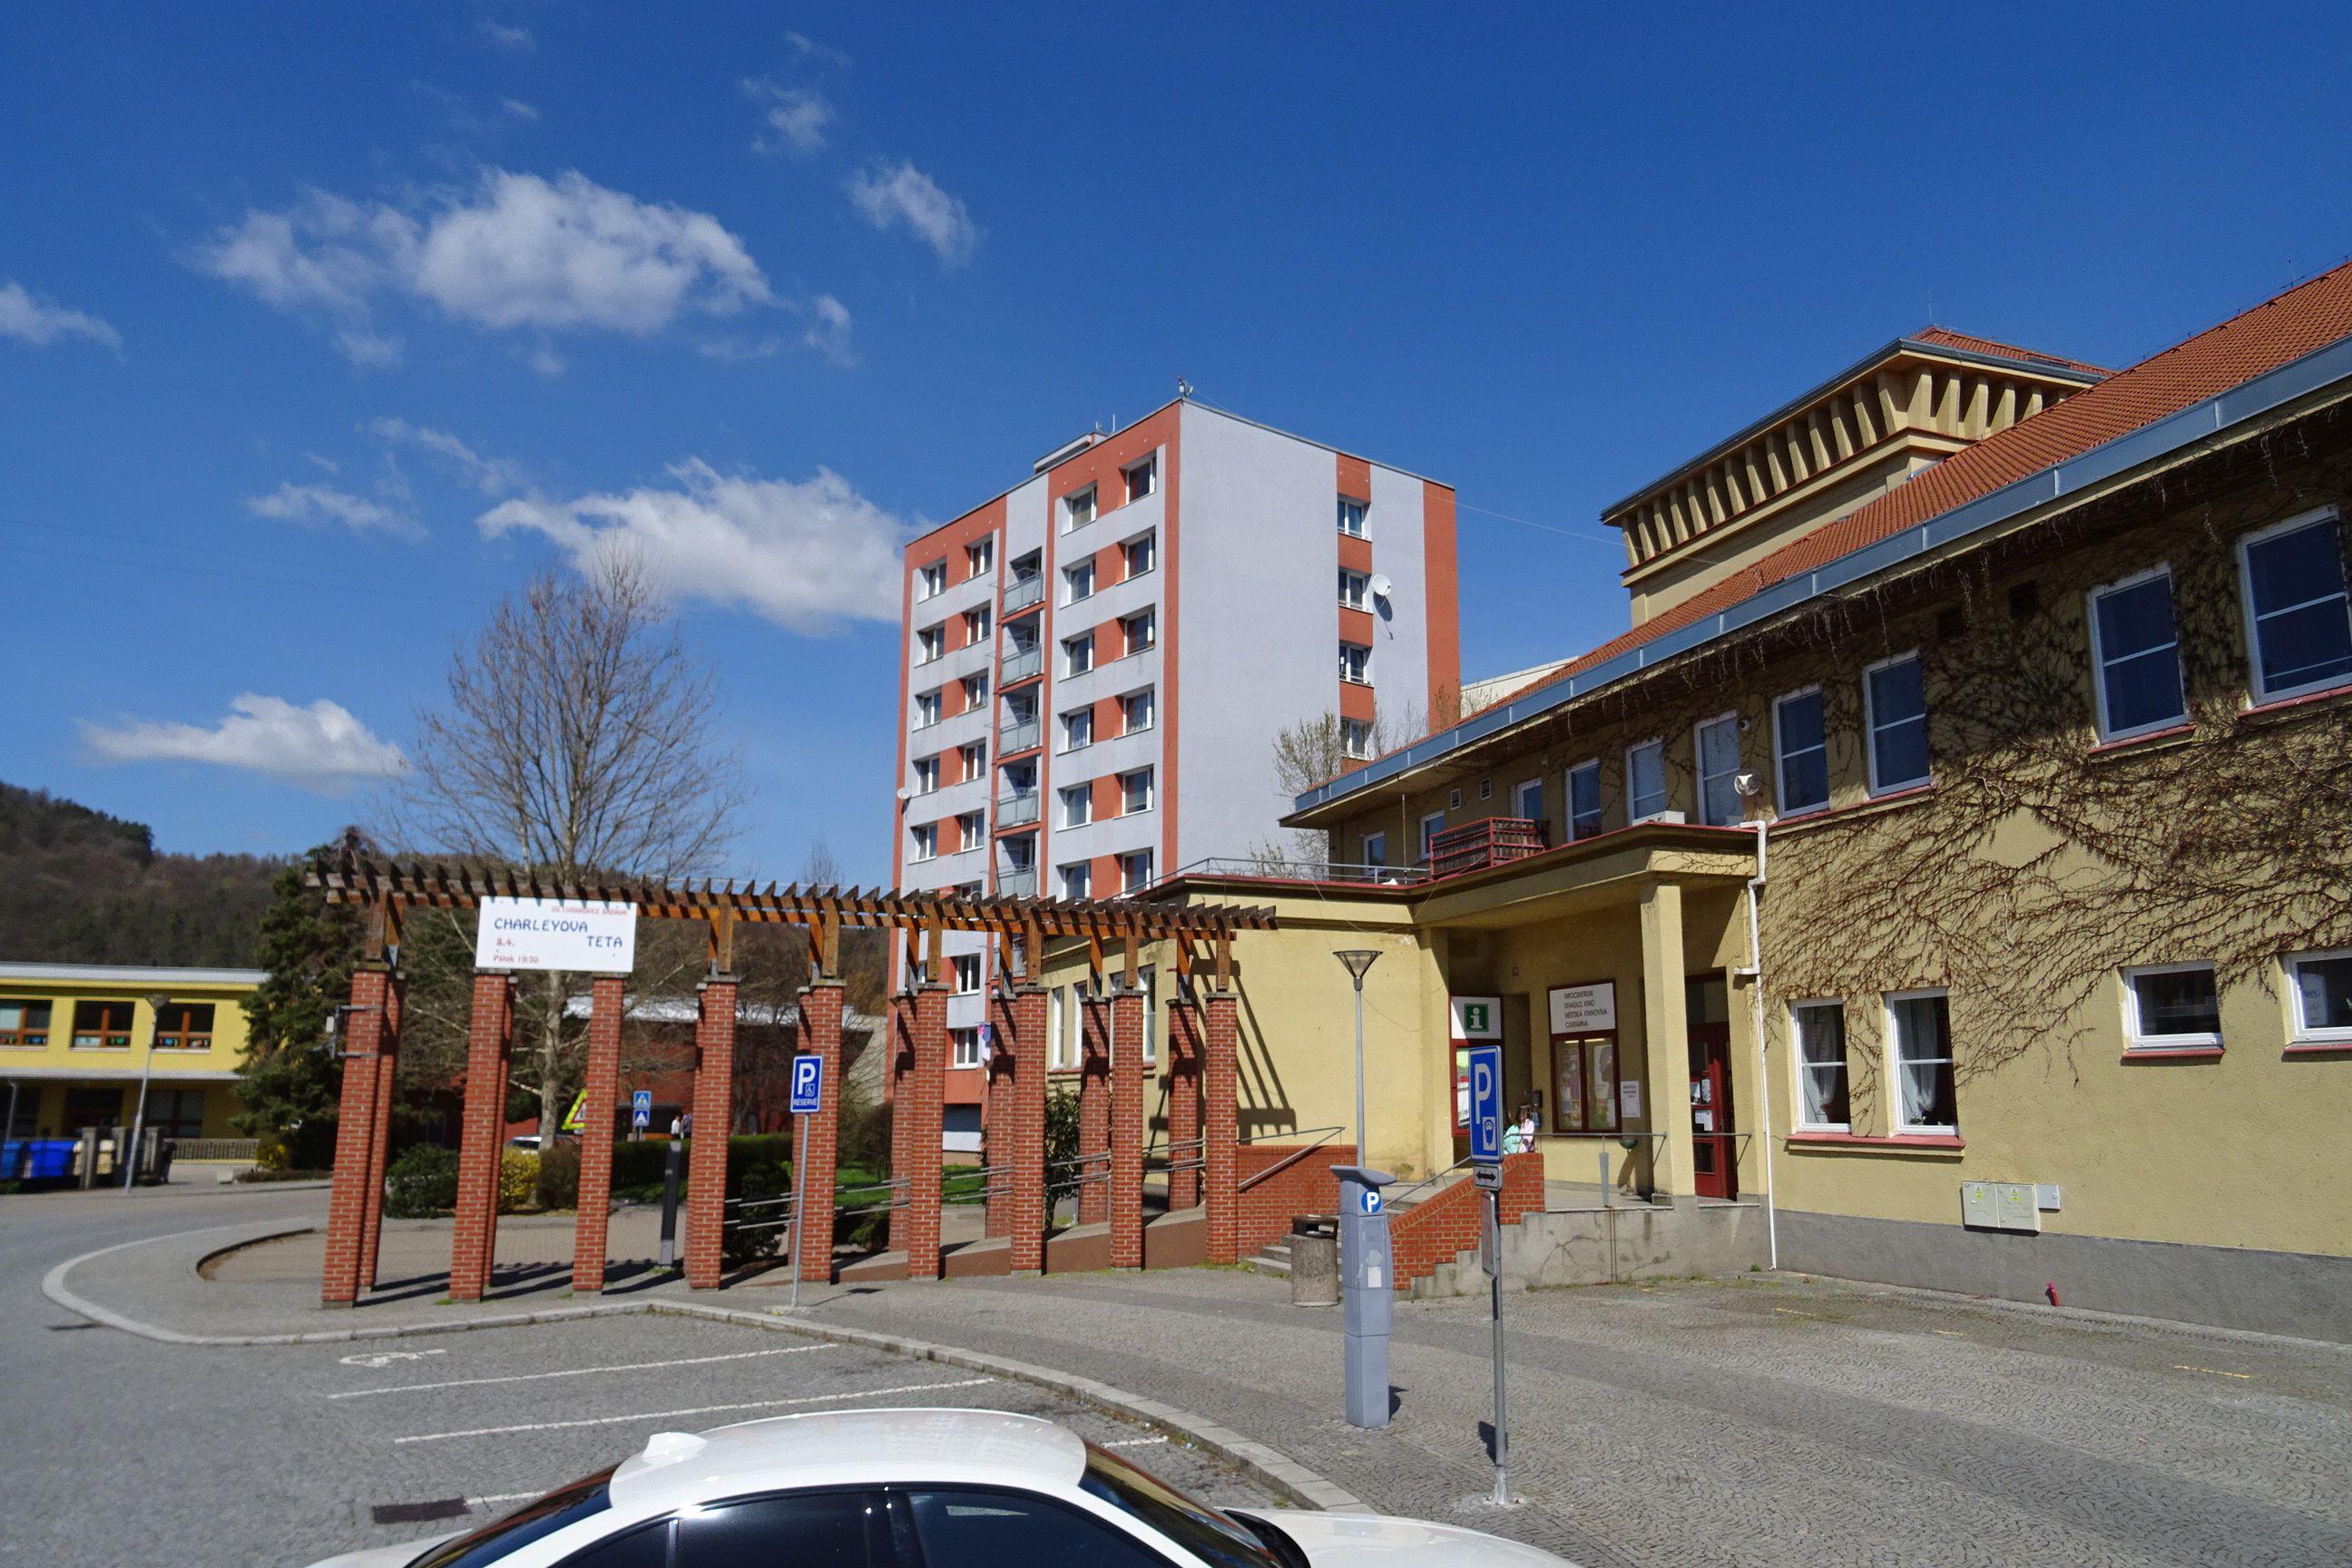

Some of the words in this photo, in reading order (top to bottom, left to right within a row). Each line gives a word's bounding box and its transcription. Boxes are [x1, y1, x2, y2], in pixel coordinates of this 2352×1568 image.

[494, 917, 588, 933] CHARLEYOVA
[586, 935, 623, 948] TETA
[798, 1063, 816, 1095] P
[1475, 1063, 1492, 1124] P
[1366, 1191, 1379, 1213] P
